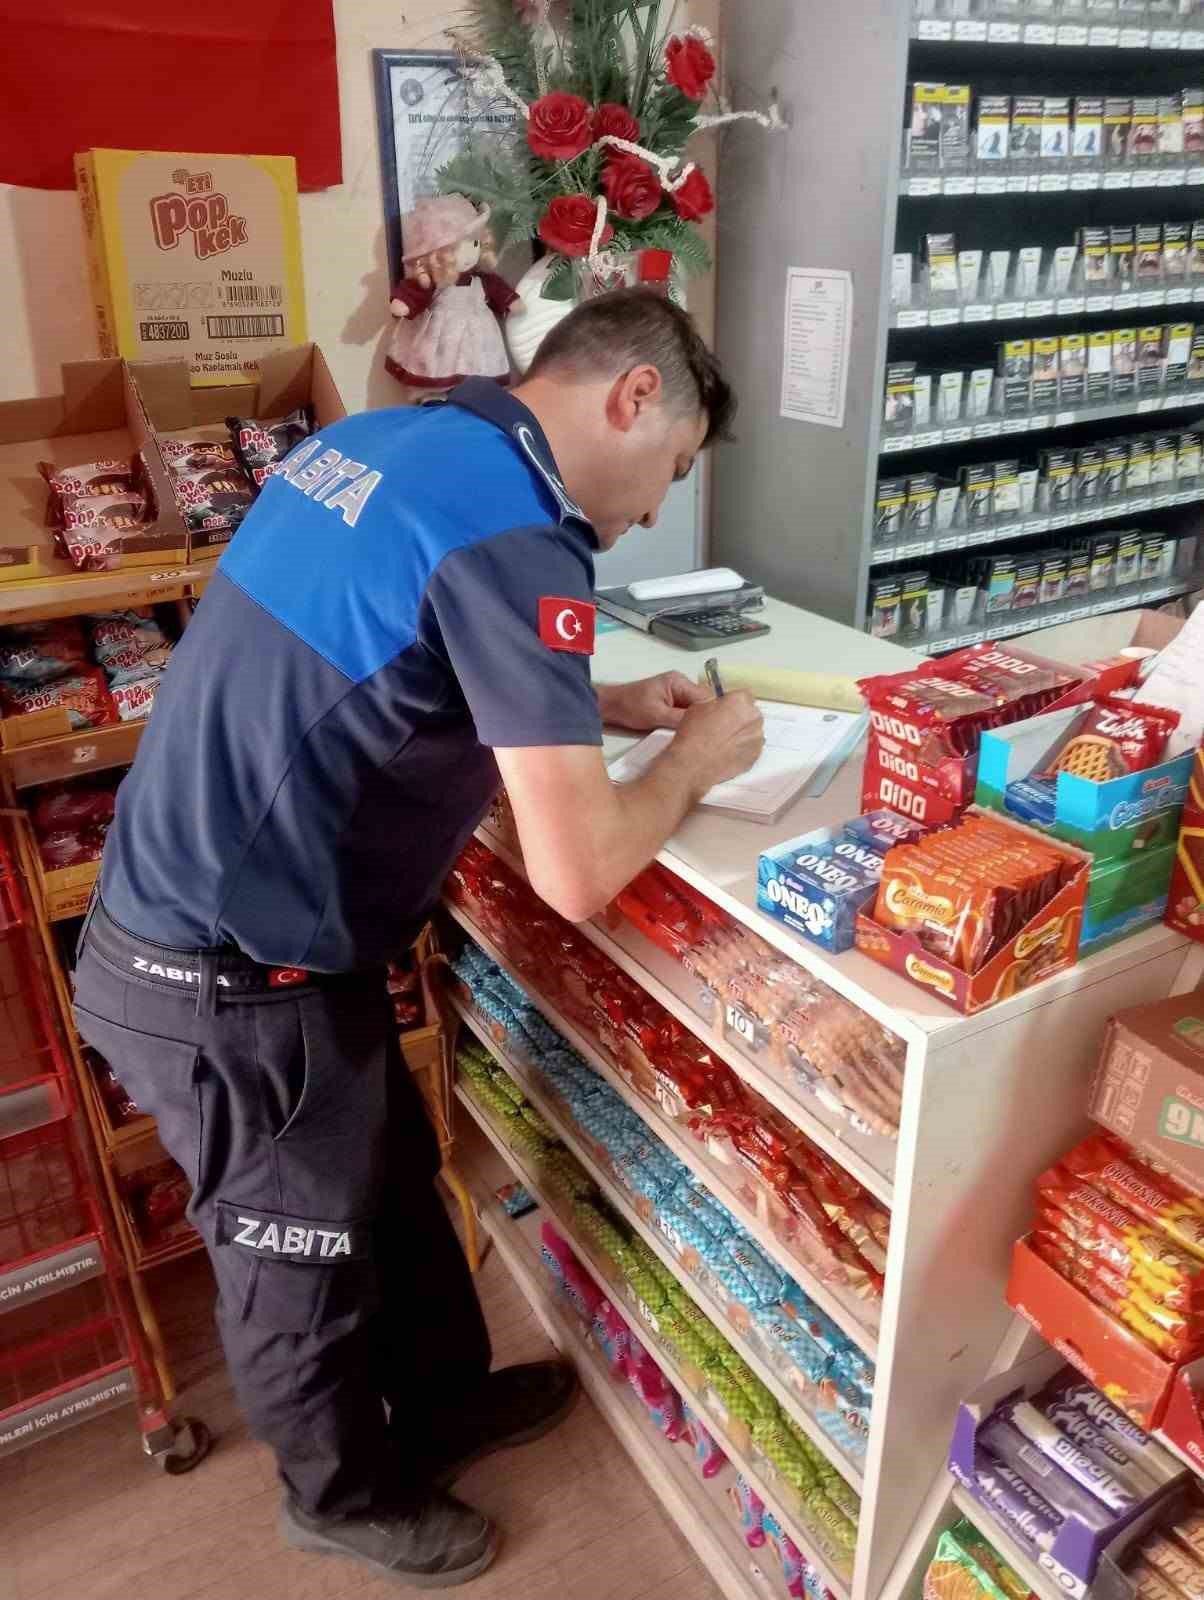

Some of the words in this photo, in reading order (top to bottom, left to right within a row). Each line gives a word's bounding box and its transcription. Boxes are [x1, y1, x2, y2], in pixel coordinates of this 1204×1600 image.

[221, 269, 253, 281] Muzlu
[272, 440, 384, 528] ABITA
[233, 1216, 351, 1257] ZABITA
